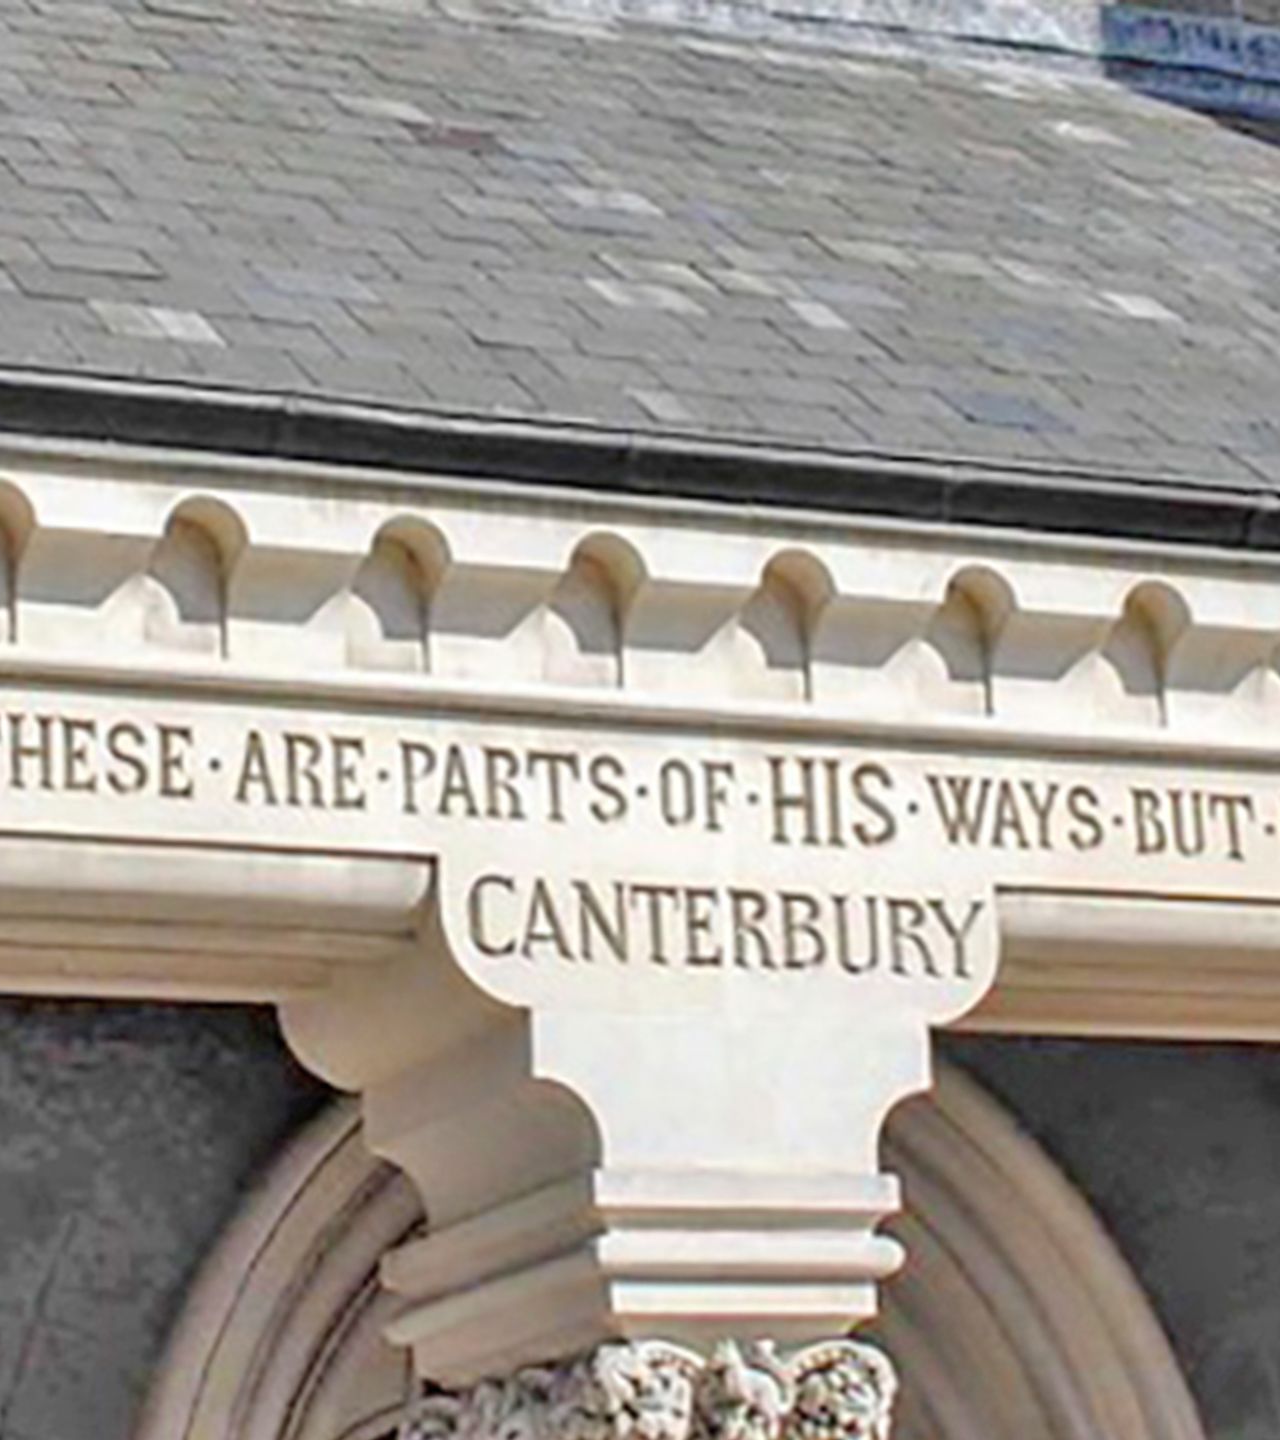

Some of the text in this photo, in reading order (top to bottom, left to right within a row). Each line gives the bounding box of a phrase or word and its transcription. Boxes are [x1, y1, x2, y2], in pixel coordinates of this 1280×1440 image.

[235, 731, 365, 808] ARE
[402, 741, 626, 824] PARTS
[658, 759, 732, 830] OF
[766, 756, 898, 848] HIS
[926, 773, 1104, 852] WAYS
[1131, 787, 1255, 863] BUT
[467, 873, 983, 978] CANTERBURY
